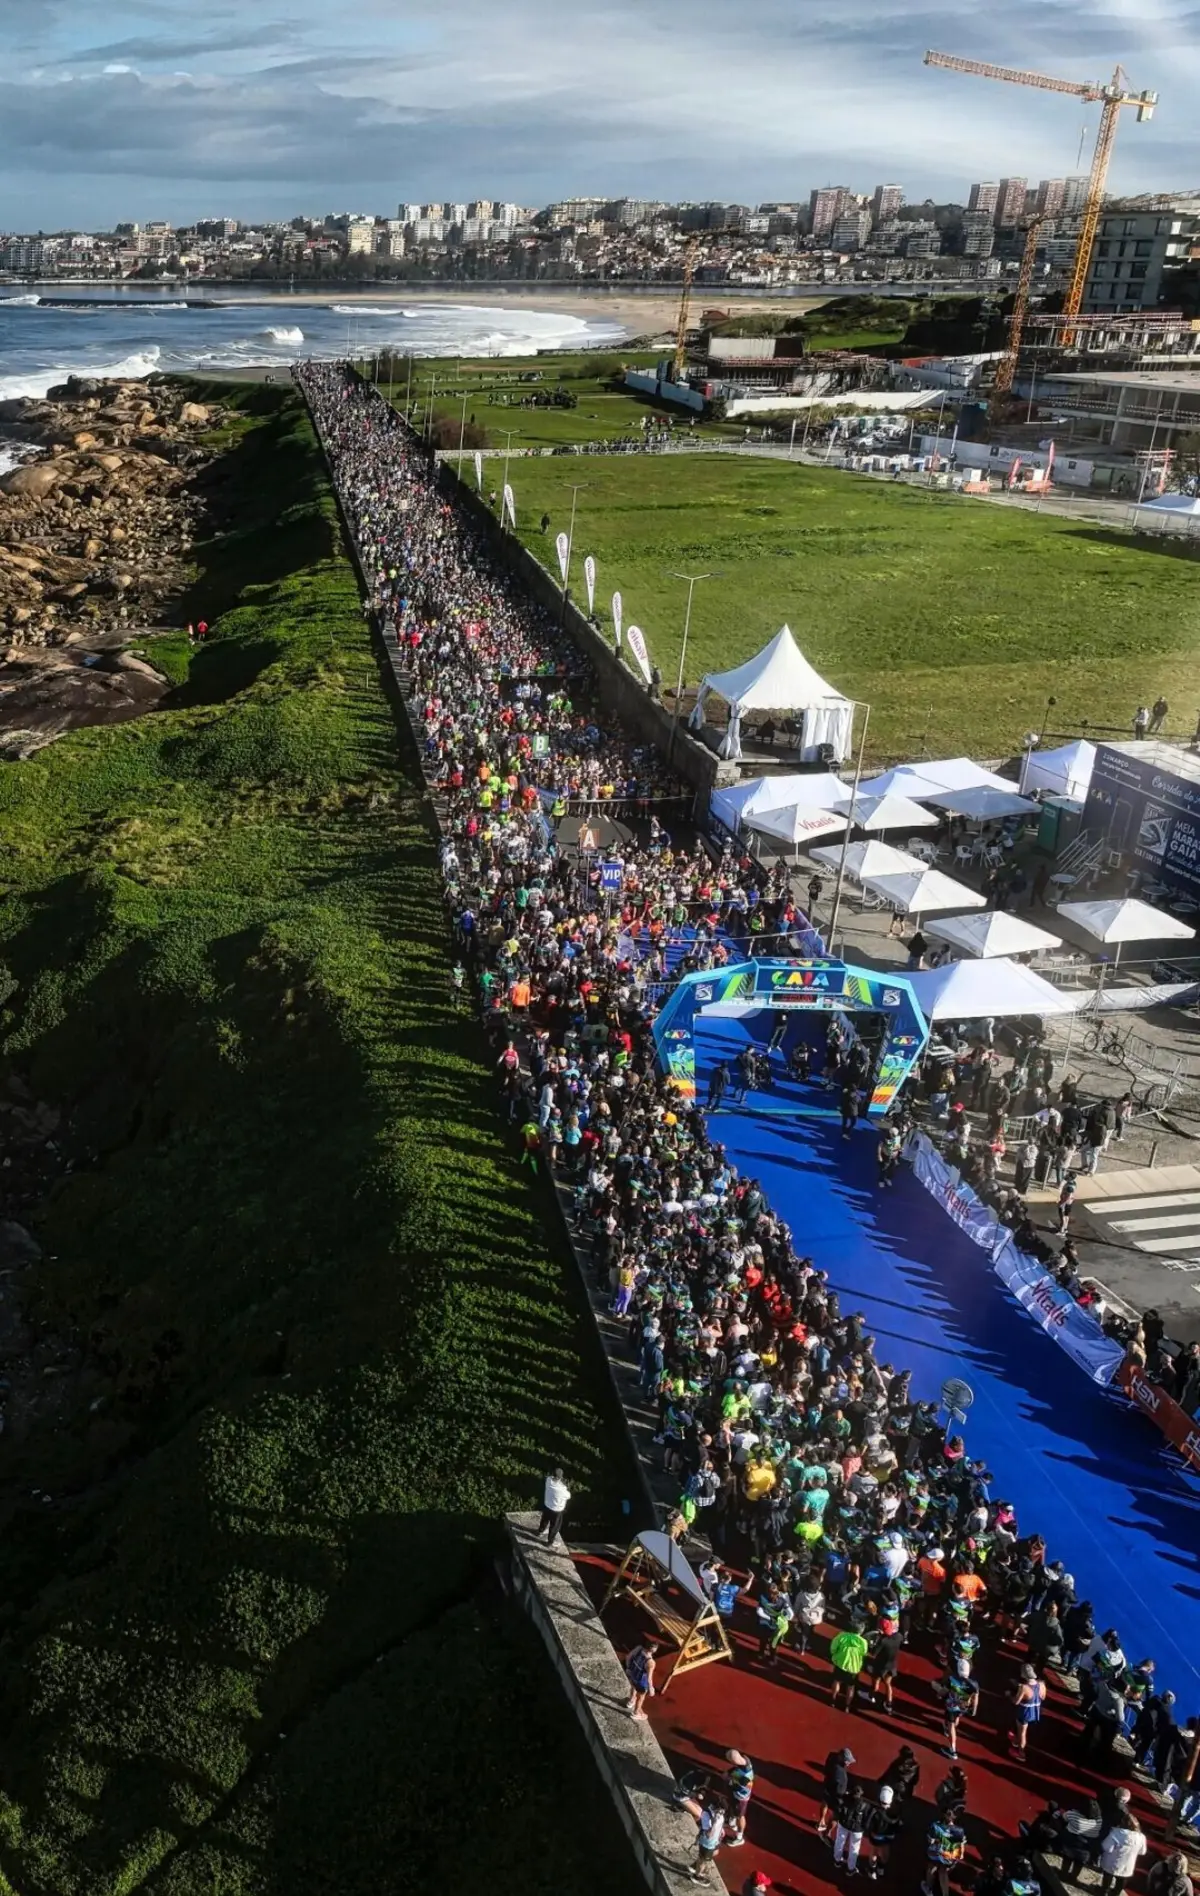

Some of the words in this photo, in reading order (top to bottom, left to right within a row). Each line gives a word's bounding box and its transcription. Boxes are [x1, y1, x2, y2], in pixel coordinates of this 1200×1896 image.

[536, 736, 545, 750] B
[798, 816, 836, 831] Vitalis
[1175, 820, 1195, 836] MEIA
[583, 829, 595, 848] A
[1170, 840, 1197, 860] GAIA
[603, 869, 621, 881] VIP
[771, 970, 829, 986] GAIA
[944, 1181, 971, 1218] Vitalis
[1031, 1279, 1069, 1327] Vitalis
[1131, 1375, 1160, 1410] HSN
